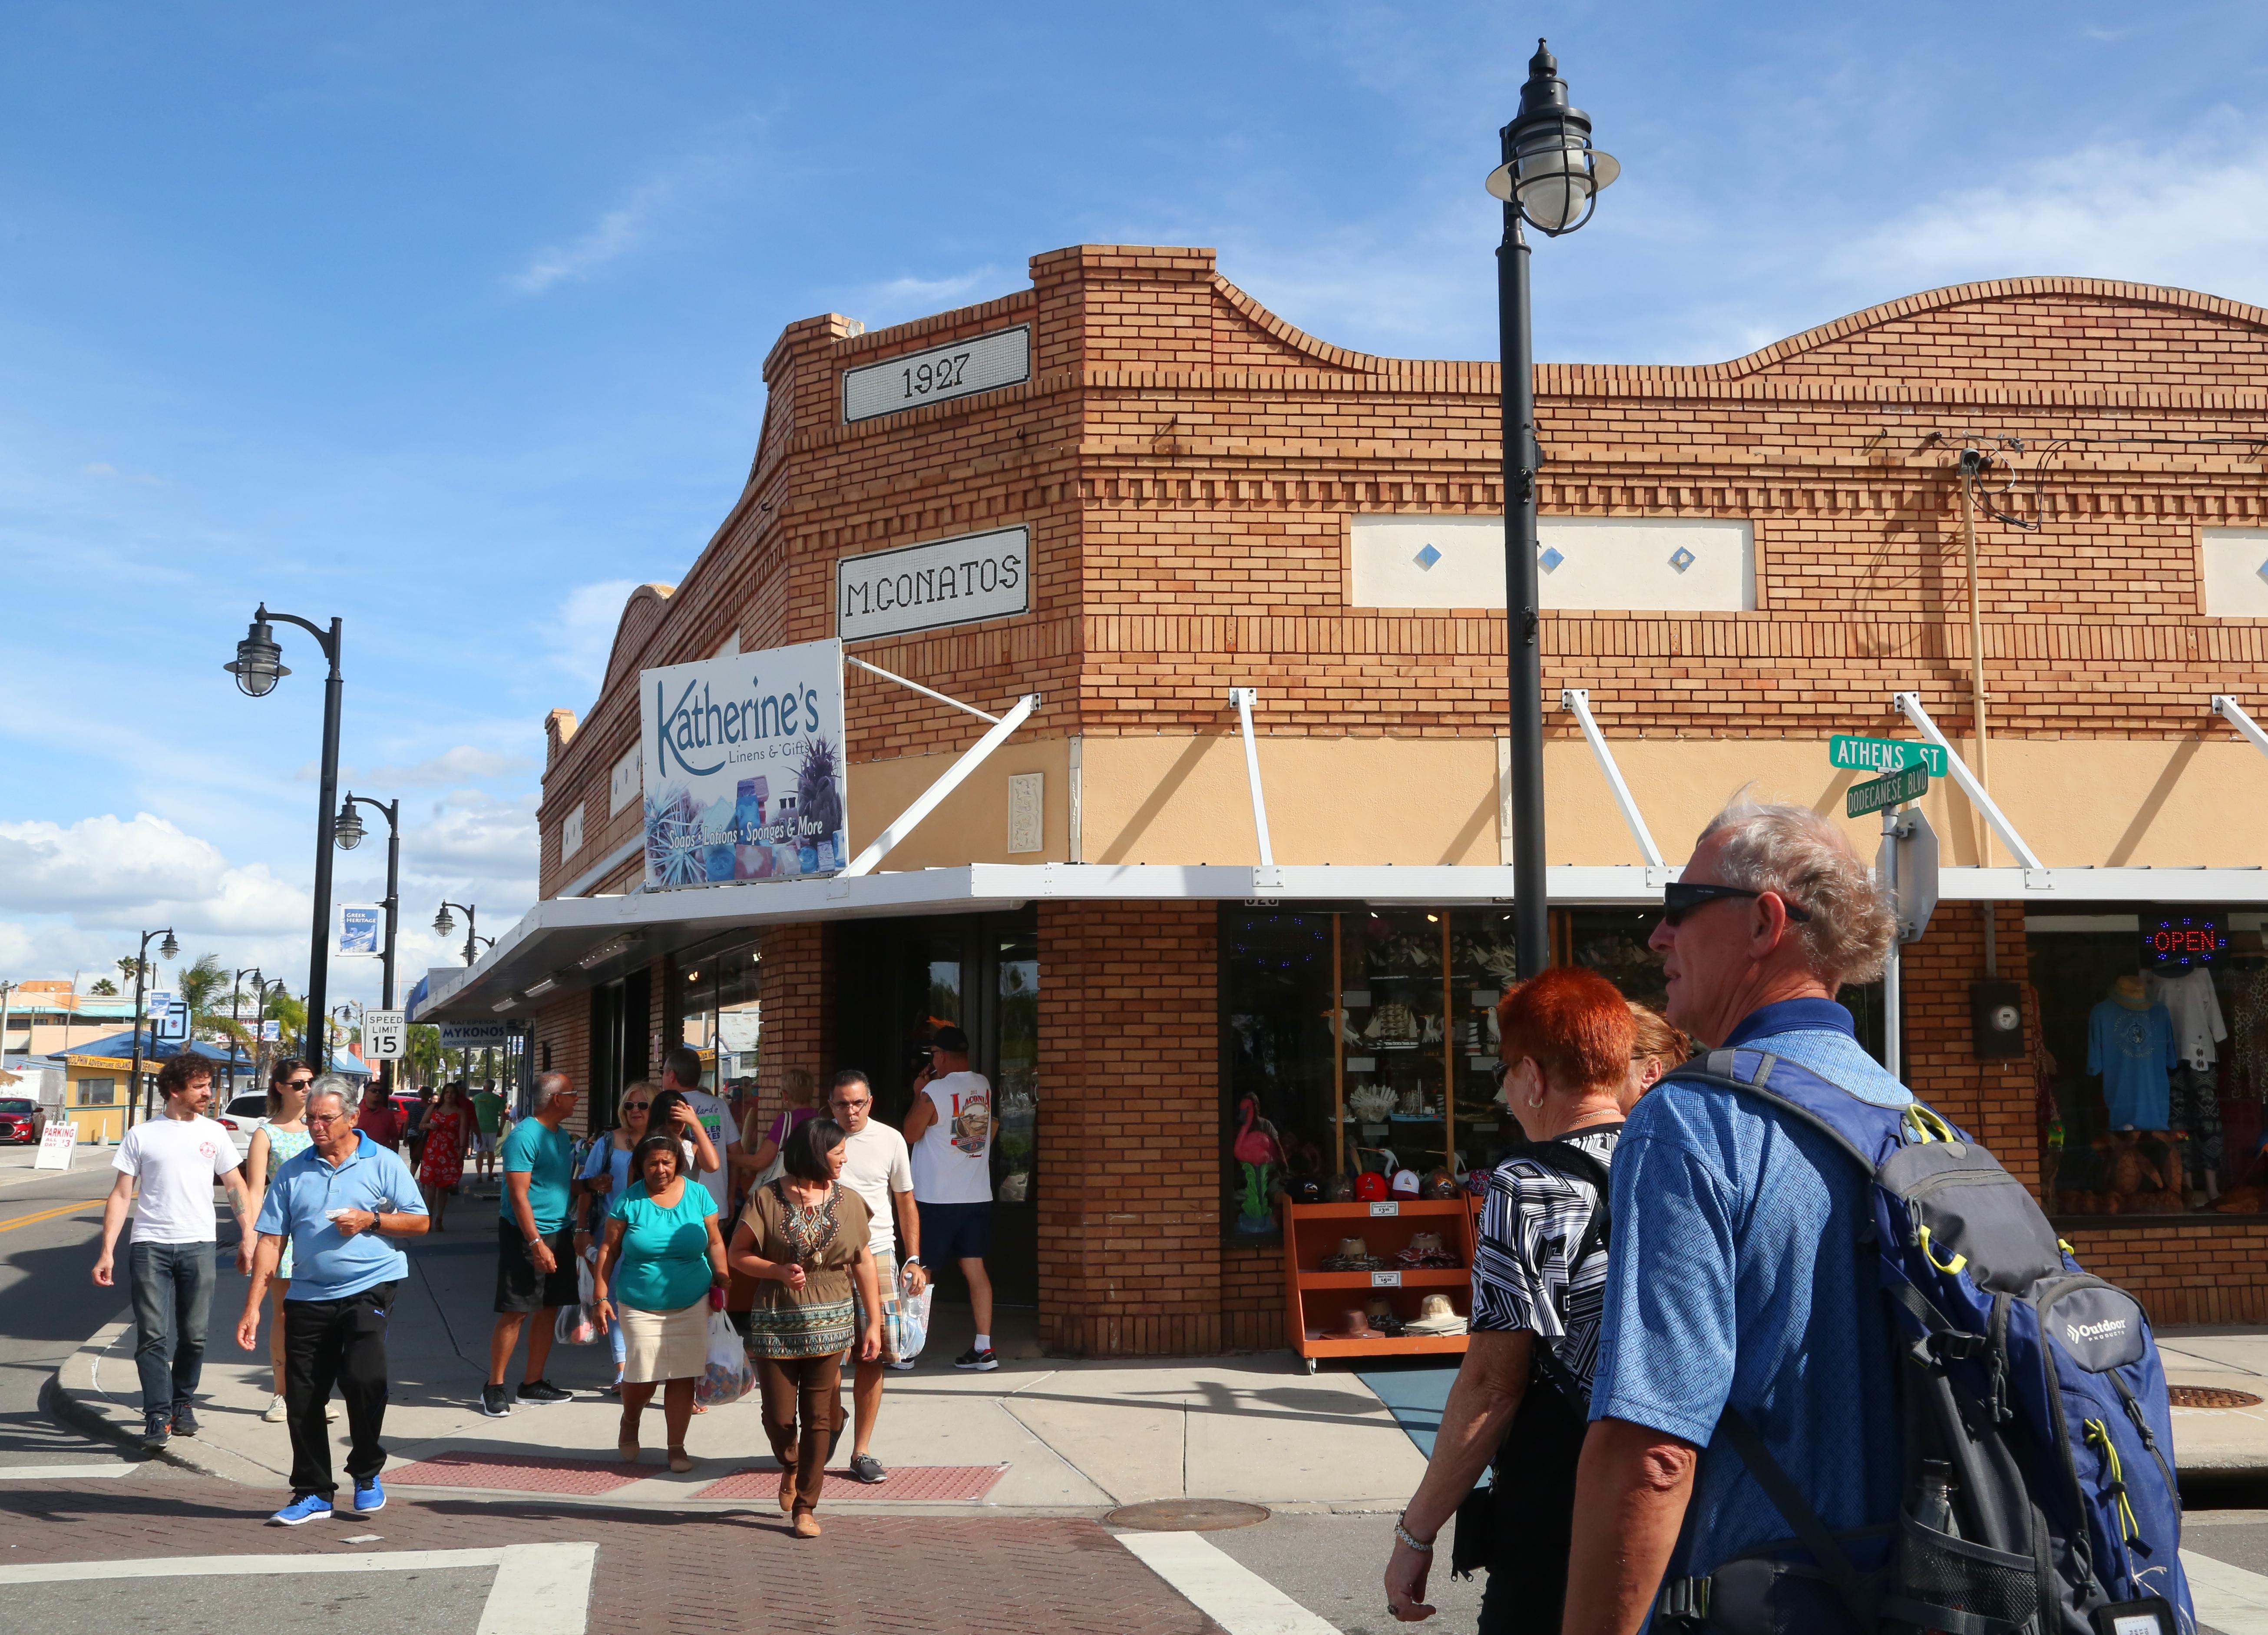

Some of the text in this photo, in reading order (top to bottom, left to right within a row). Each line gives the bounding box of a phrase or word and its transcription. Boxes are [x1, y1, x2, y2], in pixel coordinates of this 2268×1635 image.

[902, 353, 970, 398] 1927
[657, 675, 819, 778] Katherine's
[729, 741, 810, 764] Linens & Gifts
[1837, 740, 1939, 772] ATHENS ST
[1848, 768, 1927, 814] DODECANESE BLVD
[669, 816, 823, 850] Soaps Lotions Sponges & More
[2155, 931, 2215, 951] OPEN
[442, 1026, 505, 1038] MYKONOS
[373, 1036, 397, 1053] 15
[67, 1056, 131, 1069] DOLPHIN ADVENTURE ISLAND
[950, 1088, 991, 1117] LACONIA
[44, 1127, 75, 1138] PARKING
[62, 1139, 71, 1147] $3
[2079, 1319, 2126, 1337] Outdoor
[2088, 1331, 2125, 1342] PRODUCTS
